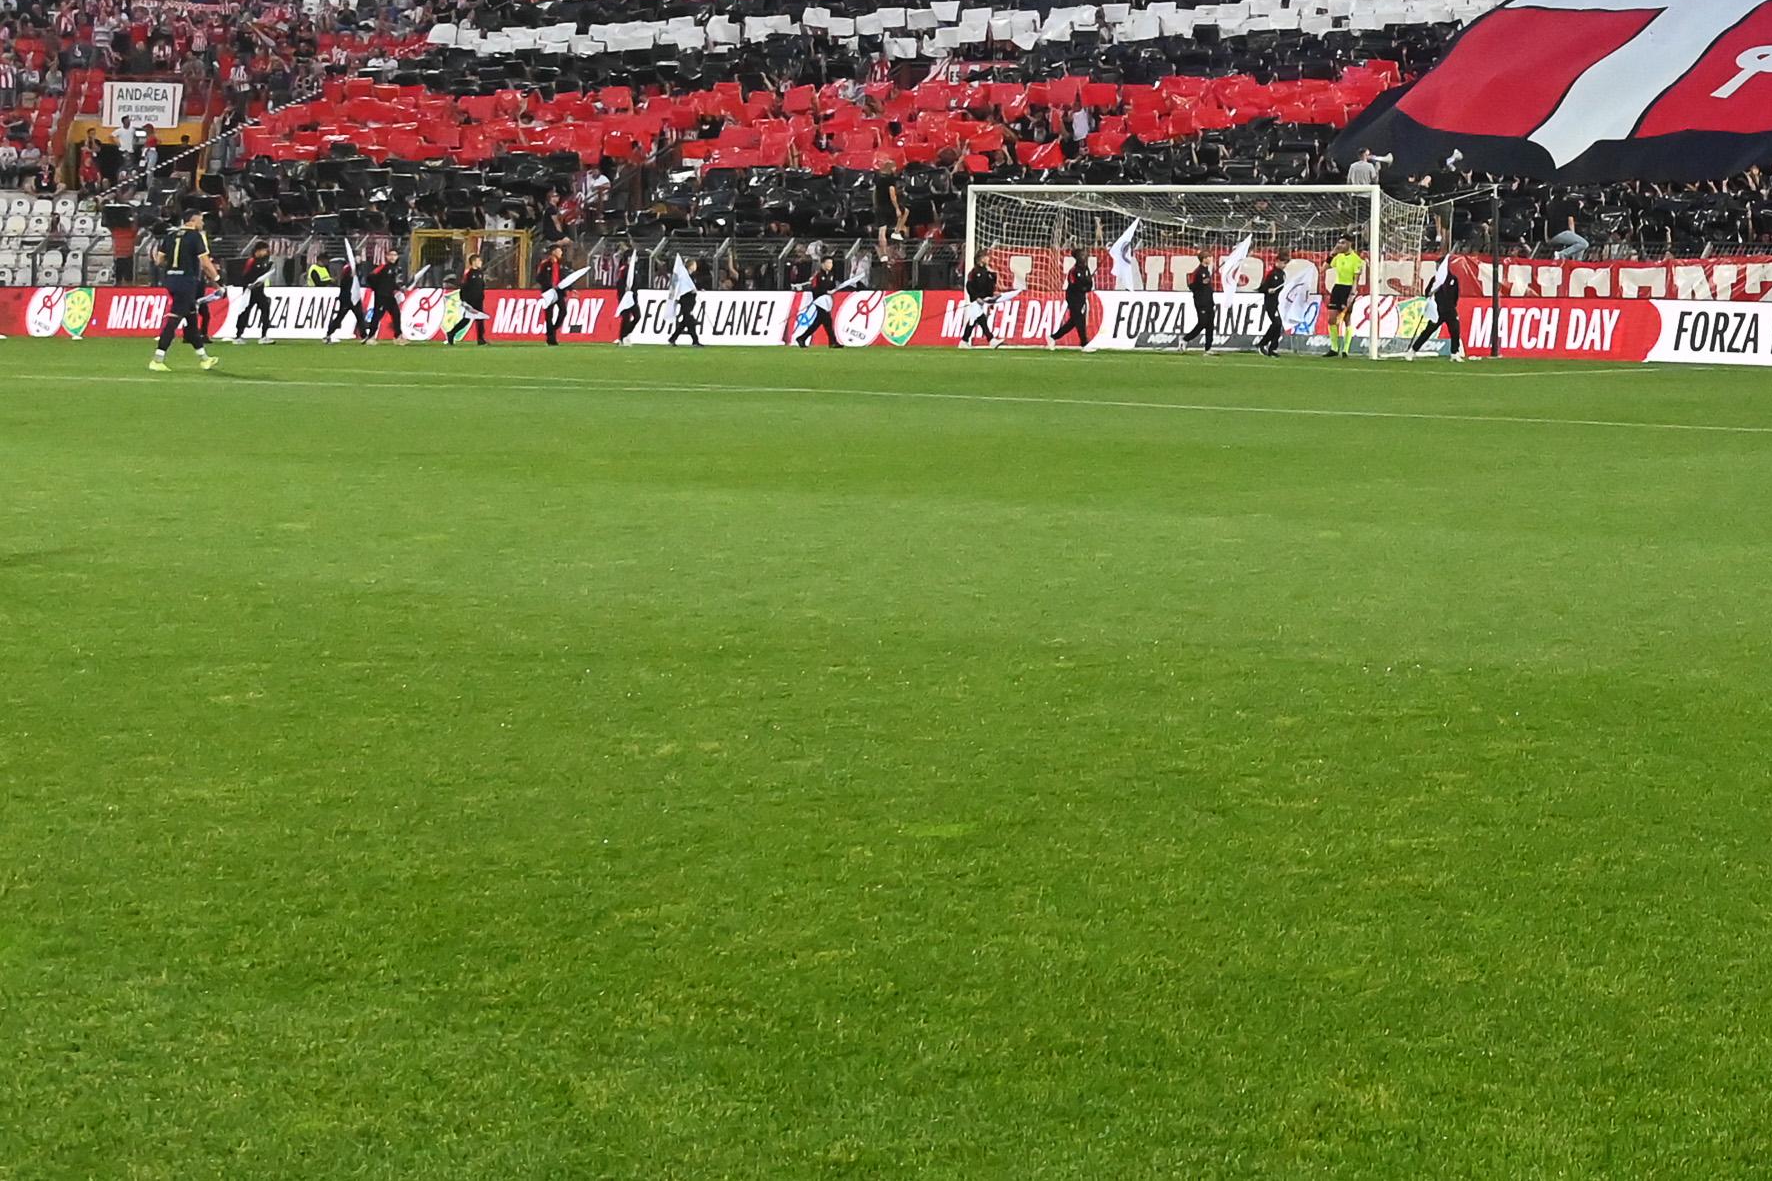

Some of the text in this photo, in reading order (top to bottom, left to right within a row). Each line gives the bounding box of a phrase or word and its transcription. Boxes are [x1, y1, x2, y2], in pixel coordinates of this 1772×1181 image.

[107, 295, 167, 329] MATCH
[562, 298, 604, 333] DAY
[713, 301, 775, 336] LANE!
[1022, 300, 1069, 339] DAY
[1113, 301, 1186, 339] FORZA
[1468, 307, 1620, 351] MATCH DAY
[1673, 311, 1759, 354] FORZA
